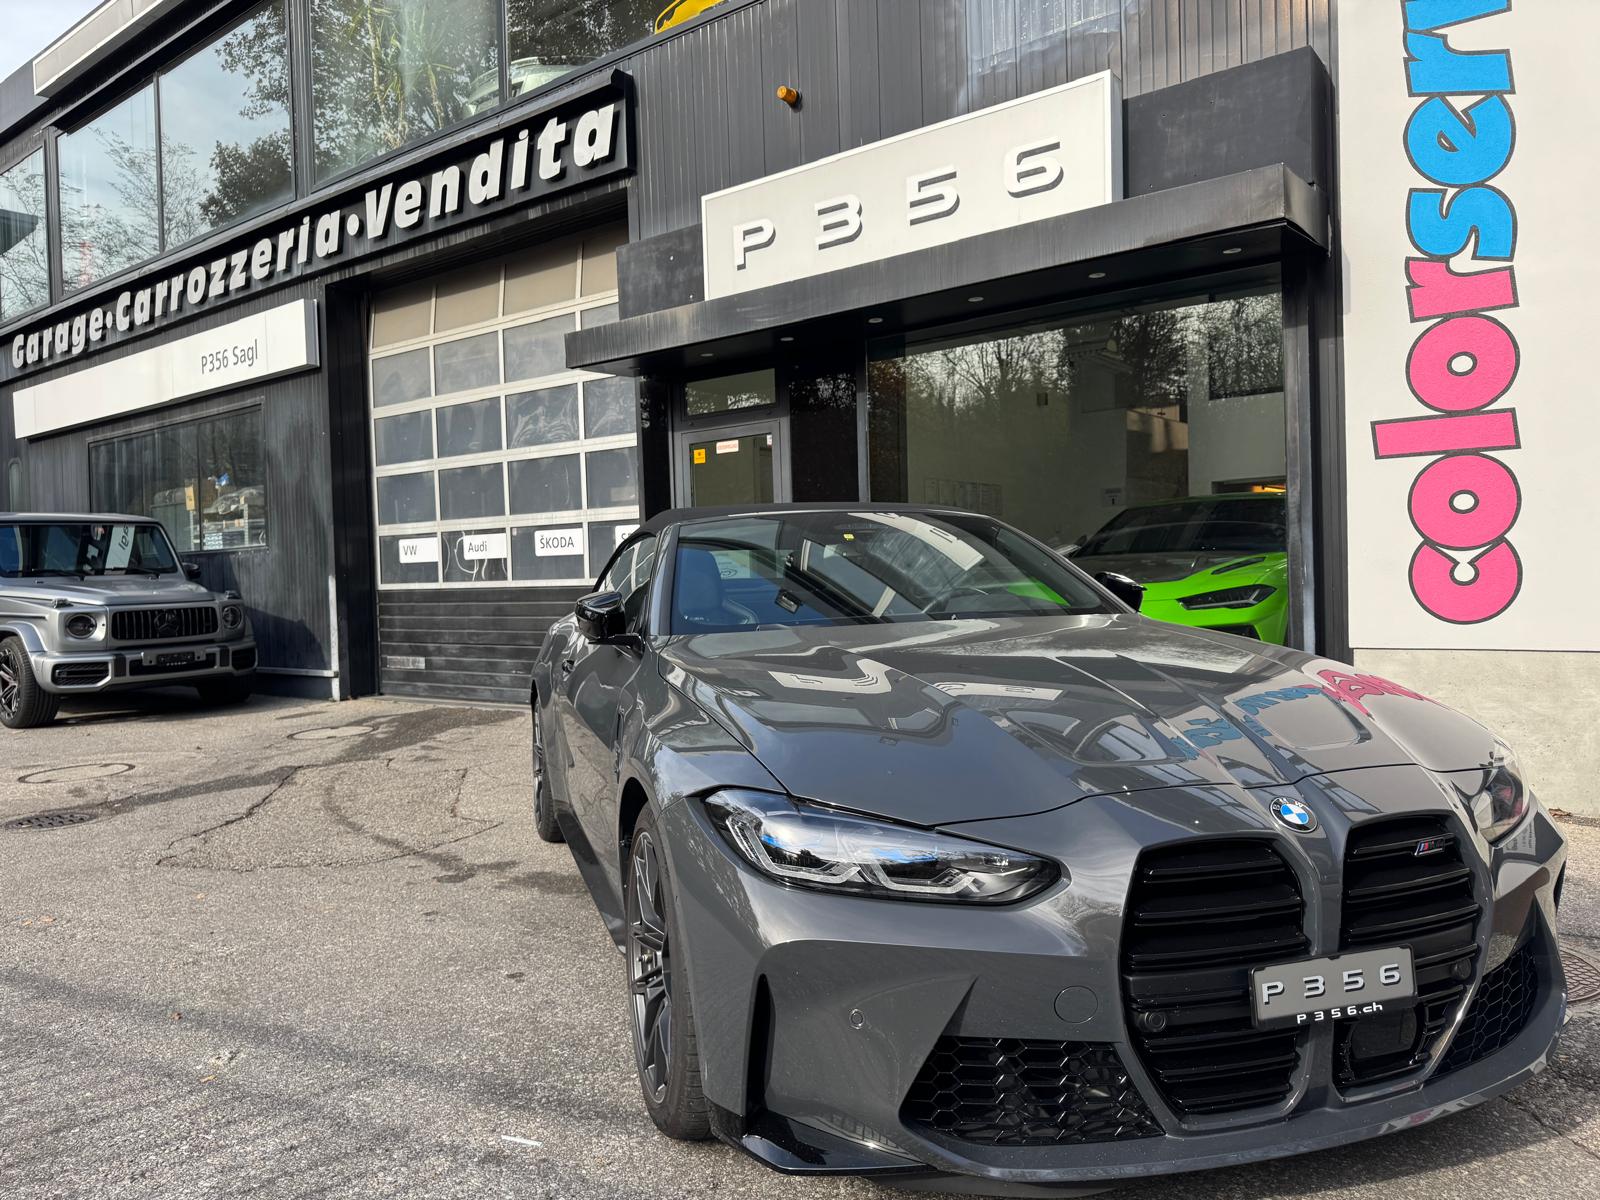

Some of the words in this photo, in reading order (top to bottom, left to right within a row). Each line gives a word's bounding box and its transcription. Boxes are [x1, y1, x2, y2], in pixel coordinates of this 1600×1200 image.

[201, 348, 229, 375] P356
[232, 337, 258, 367] Sagl
[467, 539, 488, 553] Audi
[539, 534, 575, 550] ŠKODA
[402, 545, 418, 556] VW
